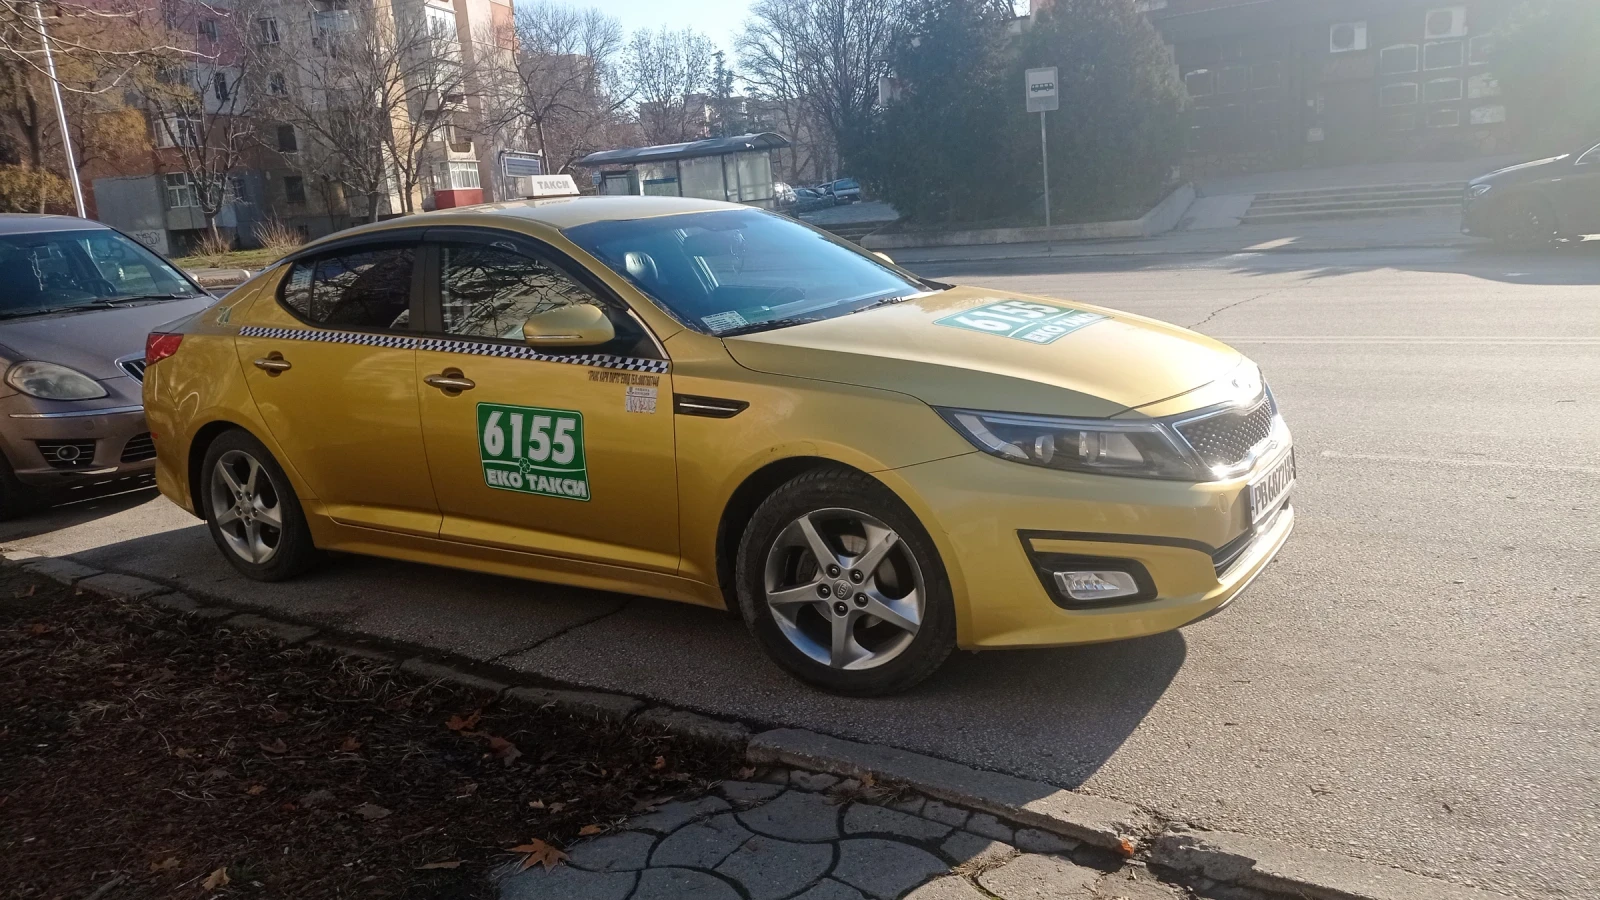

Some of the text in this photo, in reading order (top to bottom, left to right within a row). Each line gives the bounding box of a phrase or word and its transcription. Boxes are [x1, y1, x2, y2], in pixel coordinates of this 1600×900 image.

[537, 181, 570, 190] ТАКСИ
[953, 301, 1061, 331] 6155
[1021, 325, 1066, 343] ЕКО
[483, 411, 576, 465] 6155
[486, 469, 587, 497] ЕКО ТАКСИ
